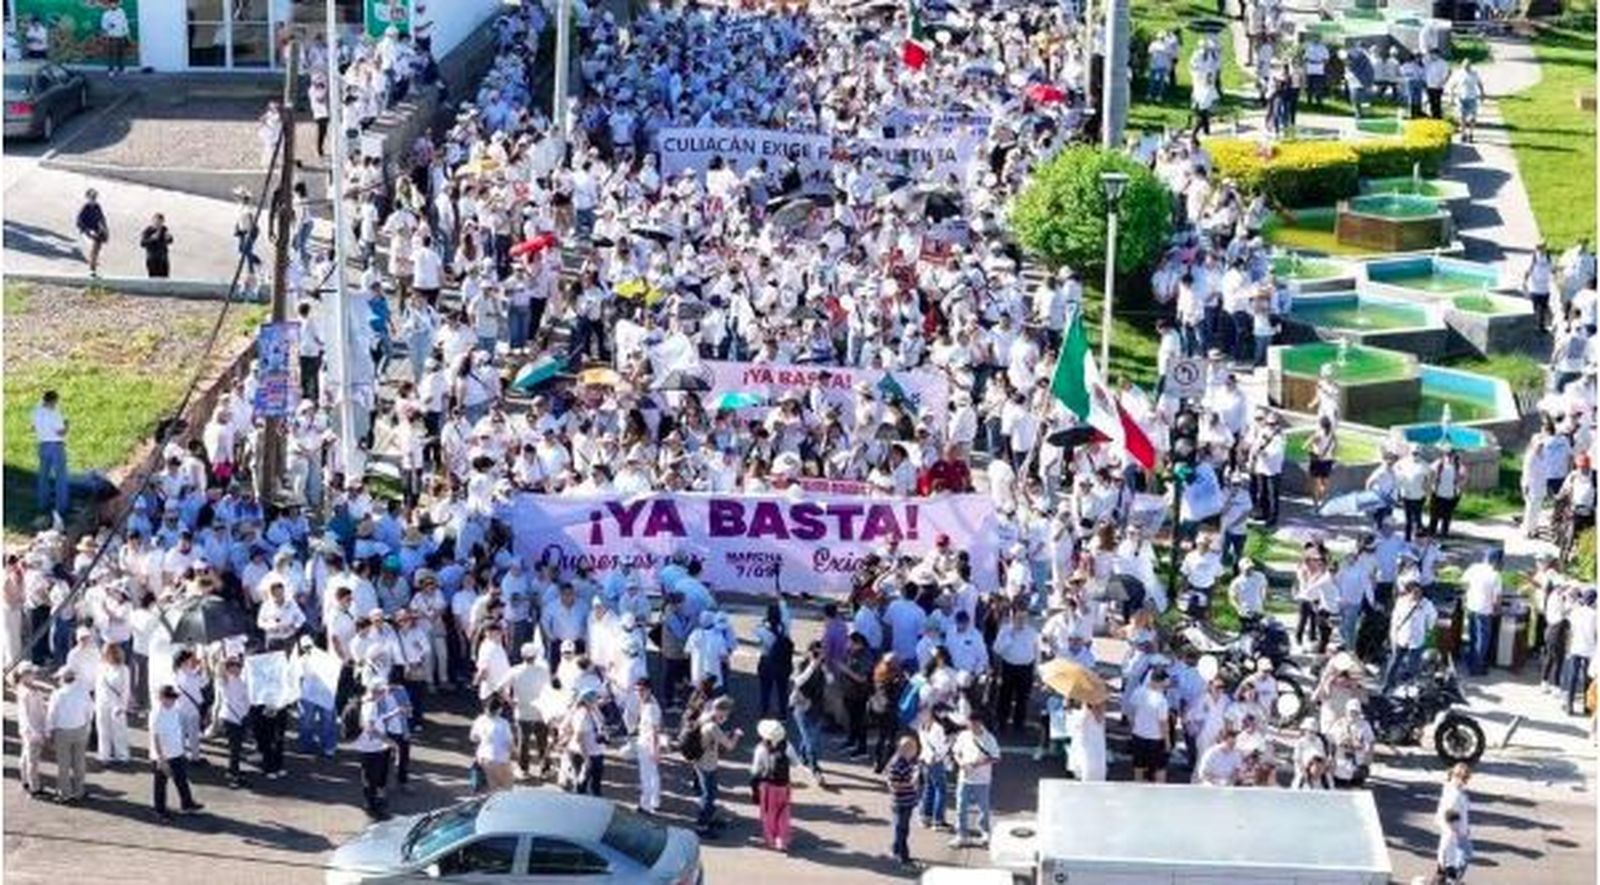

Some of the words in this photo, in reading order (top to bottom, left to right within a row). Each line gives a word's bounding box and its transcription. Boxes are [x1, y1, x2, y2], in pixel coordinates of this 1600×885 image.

[663, 136, 756, 154] CULIACÁN
[779, 371, 852, 389] BASA!
[590, 499, 688, 546] ¡YA
[708, 500, 919, 541] BASTA!
[726, 552, 783, 563] MARCHA
